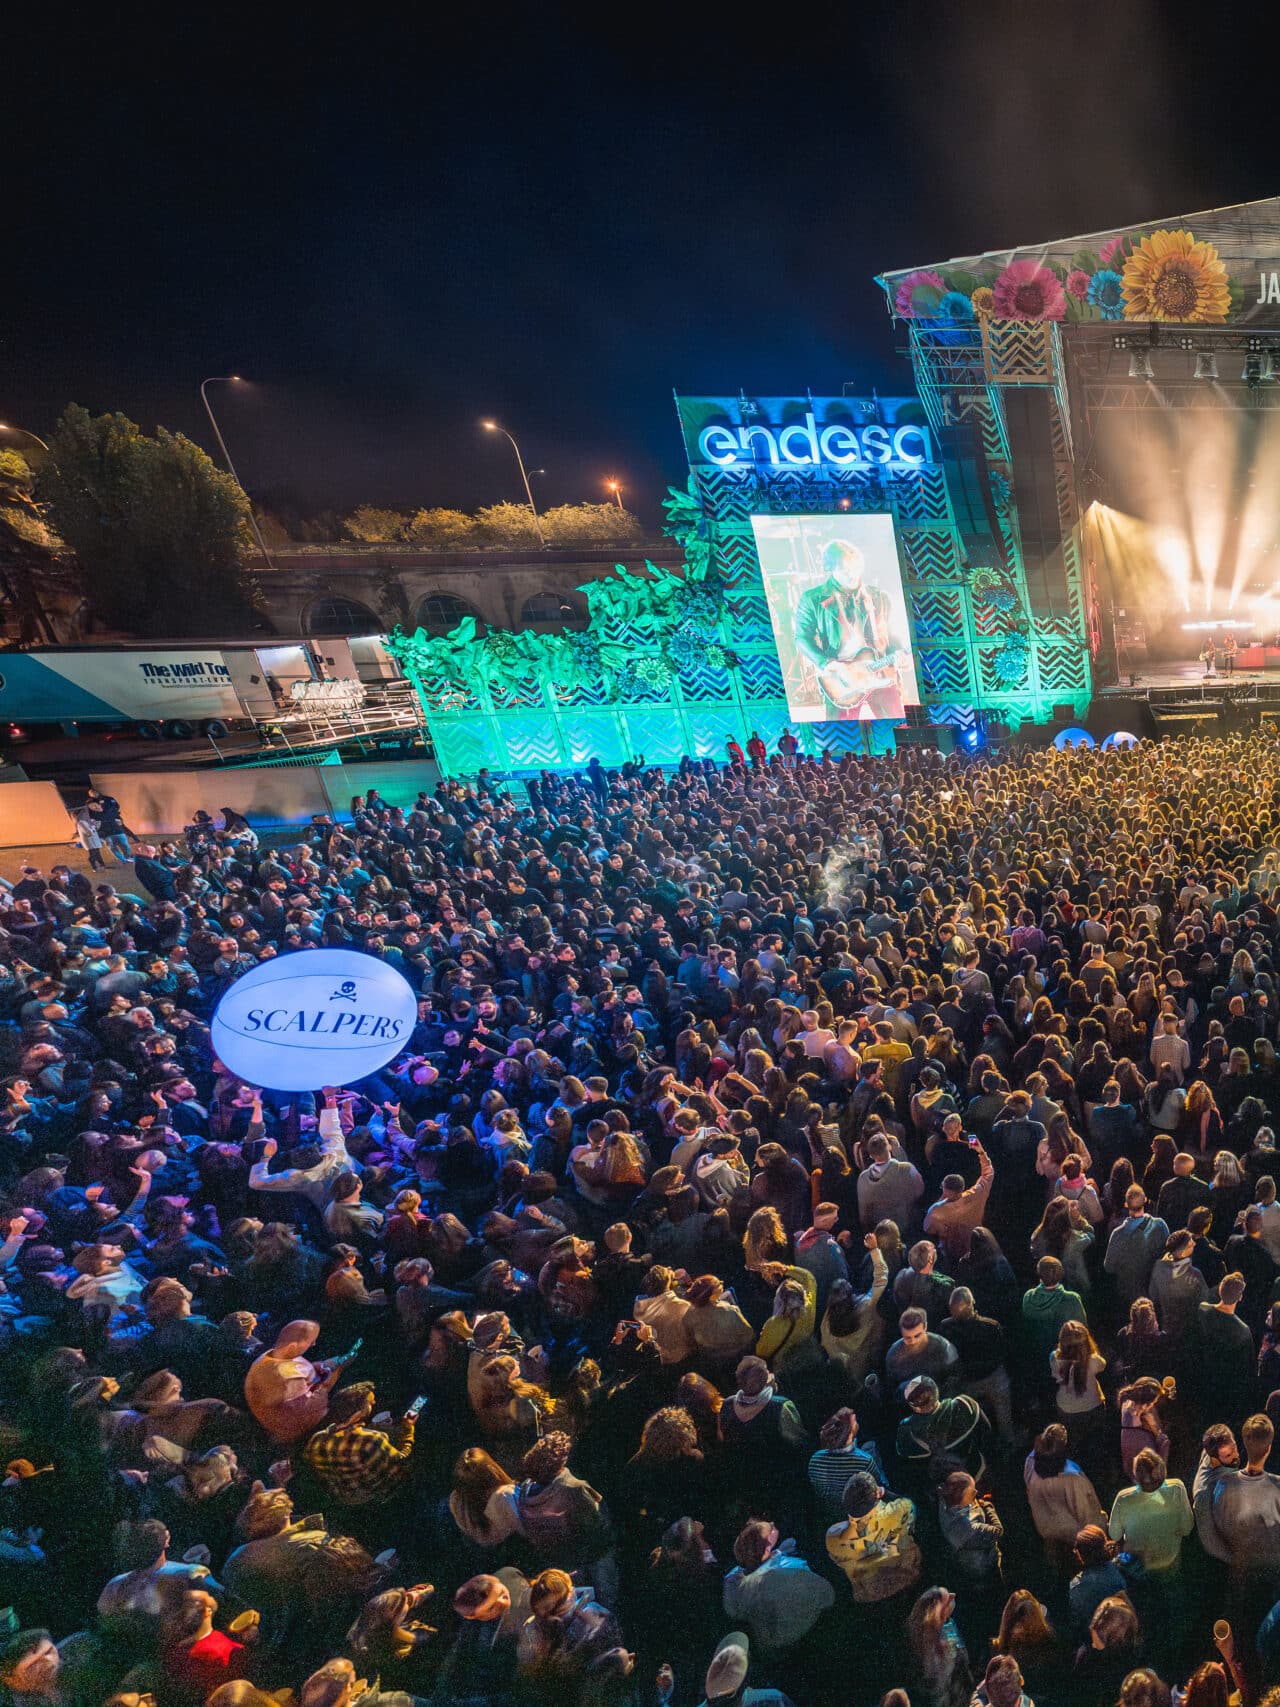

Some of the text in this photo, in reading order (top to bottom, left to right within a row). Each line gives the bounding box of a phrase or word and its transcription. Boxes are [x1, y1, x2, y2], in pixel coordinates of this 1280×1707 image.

[698, 412, 934, 465] endesa
[139, 663, 171, 677] The
[170, 662, 205, 677] Wild
[243, 1009, 404, 1040] SCALPERS
